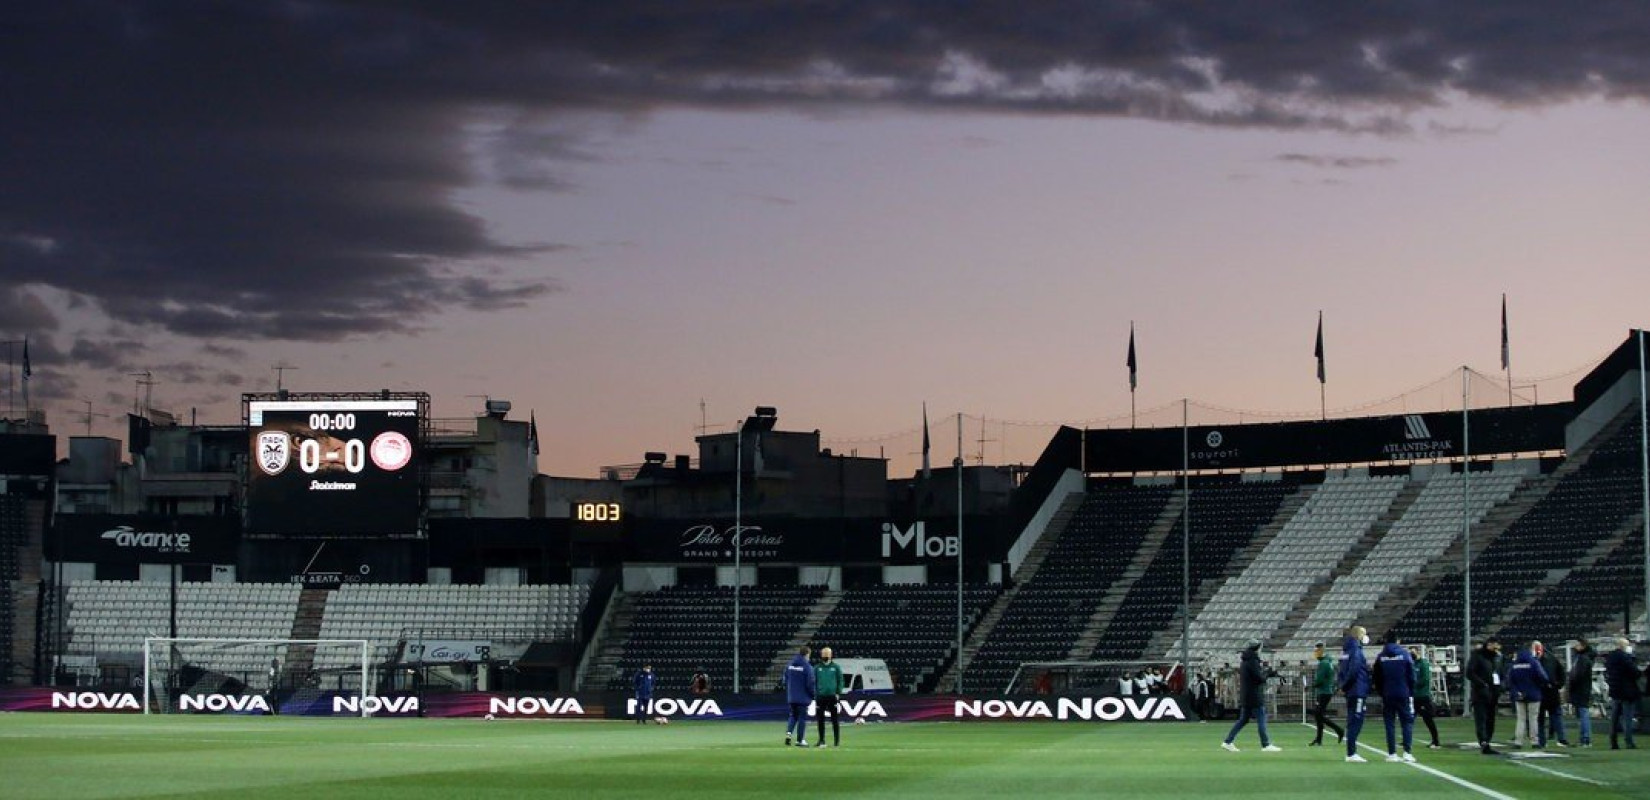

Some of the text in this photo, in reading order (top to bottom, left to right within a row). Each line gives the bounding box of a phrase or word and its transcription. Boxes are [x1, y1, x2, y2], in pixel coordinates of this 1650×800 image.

[309, 413, 356, 430] 00:00
[578, 503, 620, 520] 1803
[115, 533, 191, 547] avance
[683, 550, 718, 558] GRAND
[52, 691, 140, 709] NOVA
[179, 694, 270, 710] NOVA
[333, 696, 418, 712] NOVA
[489, 697, 585, 714] NOVA
[954, 699, 1053, 718] NOVA
[1057, 696, 1186, 720] NOVA
